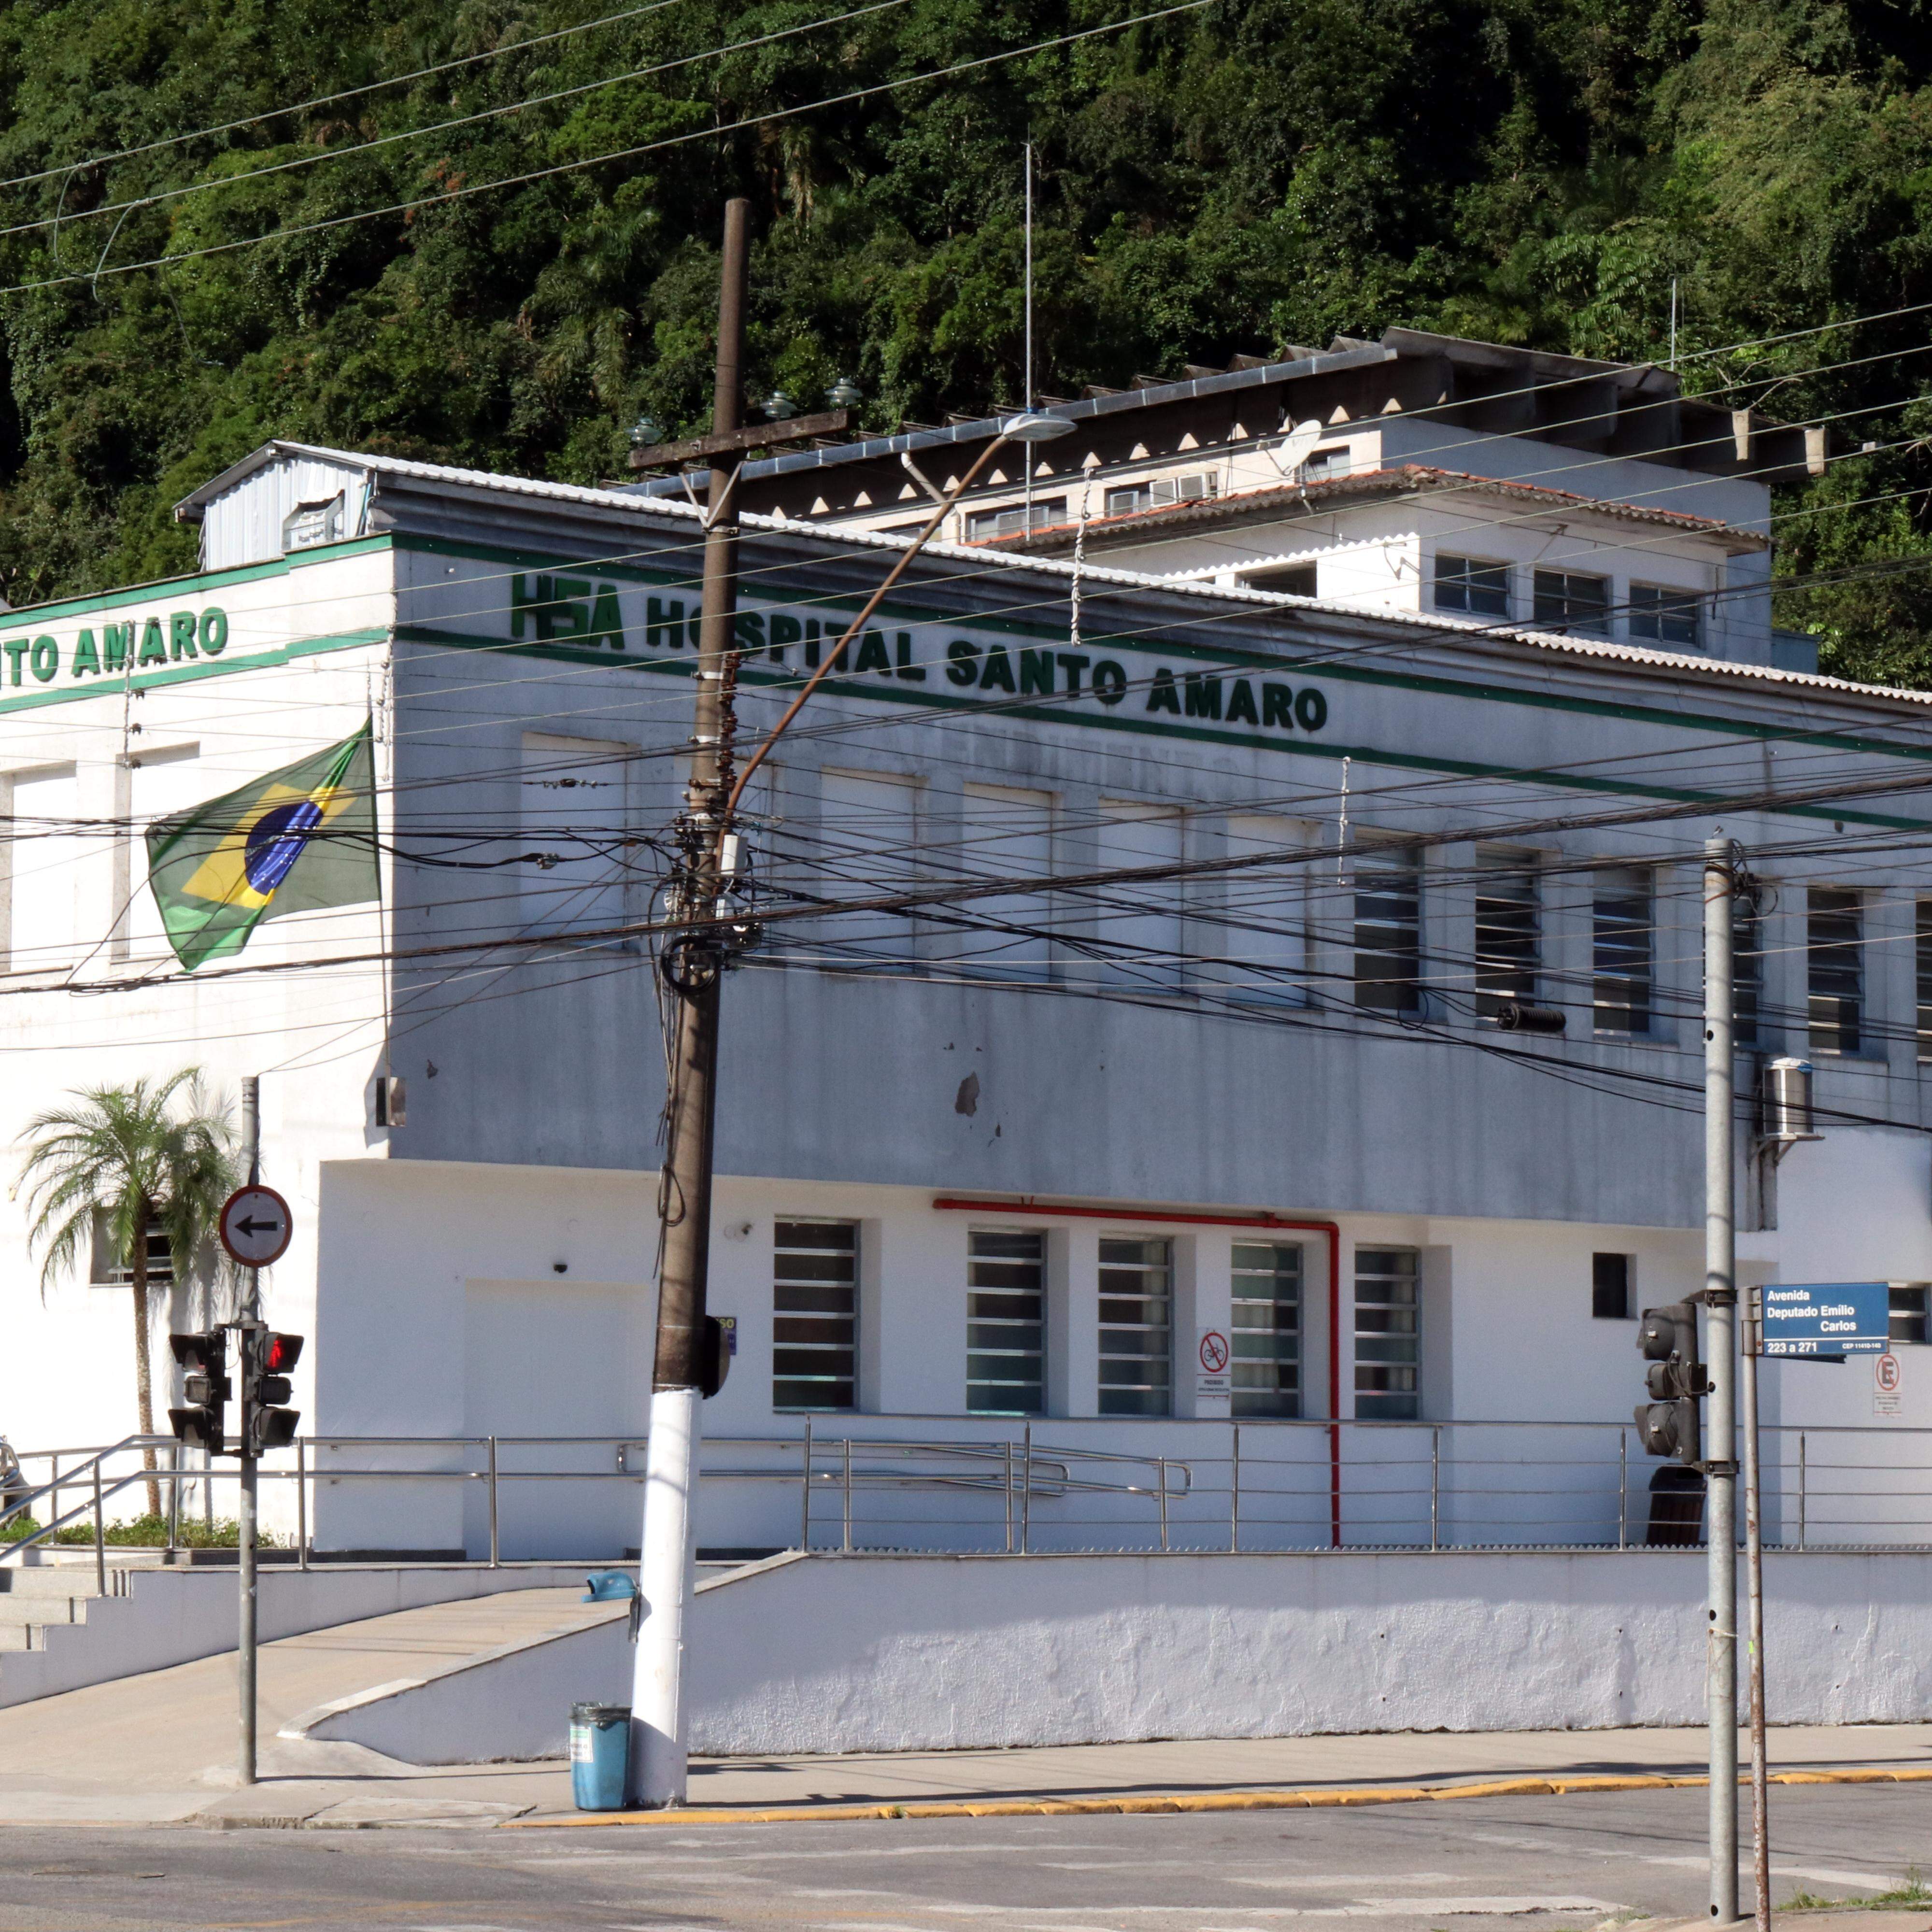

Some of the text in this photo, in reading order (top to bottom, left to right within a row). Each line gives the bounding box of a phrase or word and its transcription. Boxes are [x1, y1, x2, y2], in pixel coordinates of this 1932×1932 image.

[0, 606, 228, 690] TO AMARO
[945, 640, 1127, 705] SANTO
[1146, 668, 1328, 731] AMARO
[1767, 1290, 1810, 1301] Avenida
[1767, 1304, 1855, 1320] Deputado Emílio
[1820, 1320, 1857, 1332] Carlos
[1767, 1342, 1817, 1353] 223 a 271
